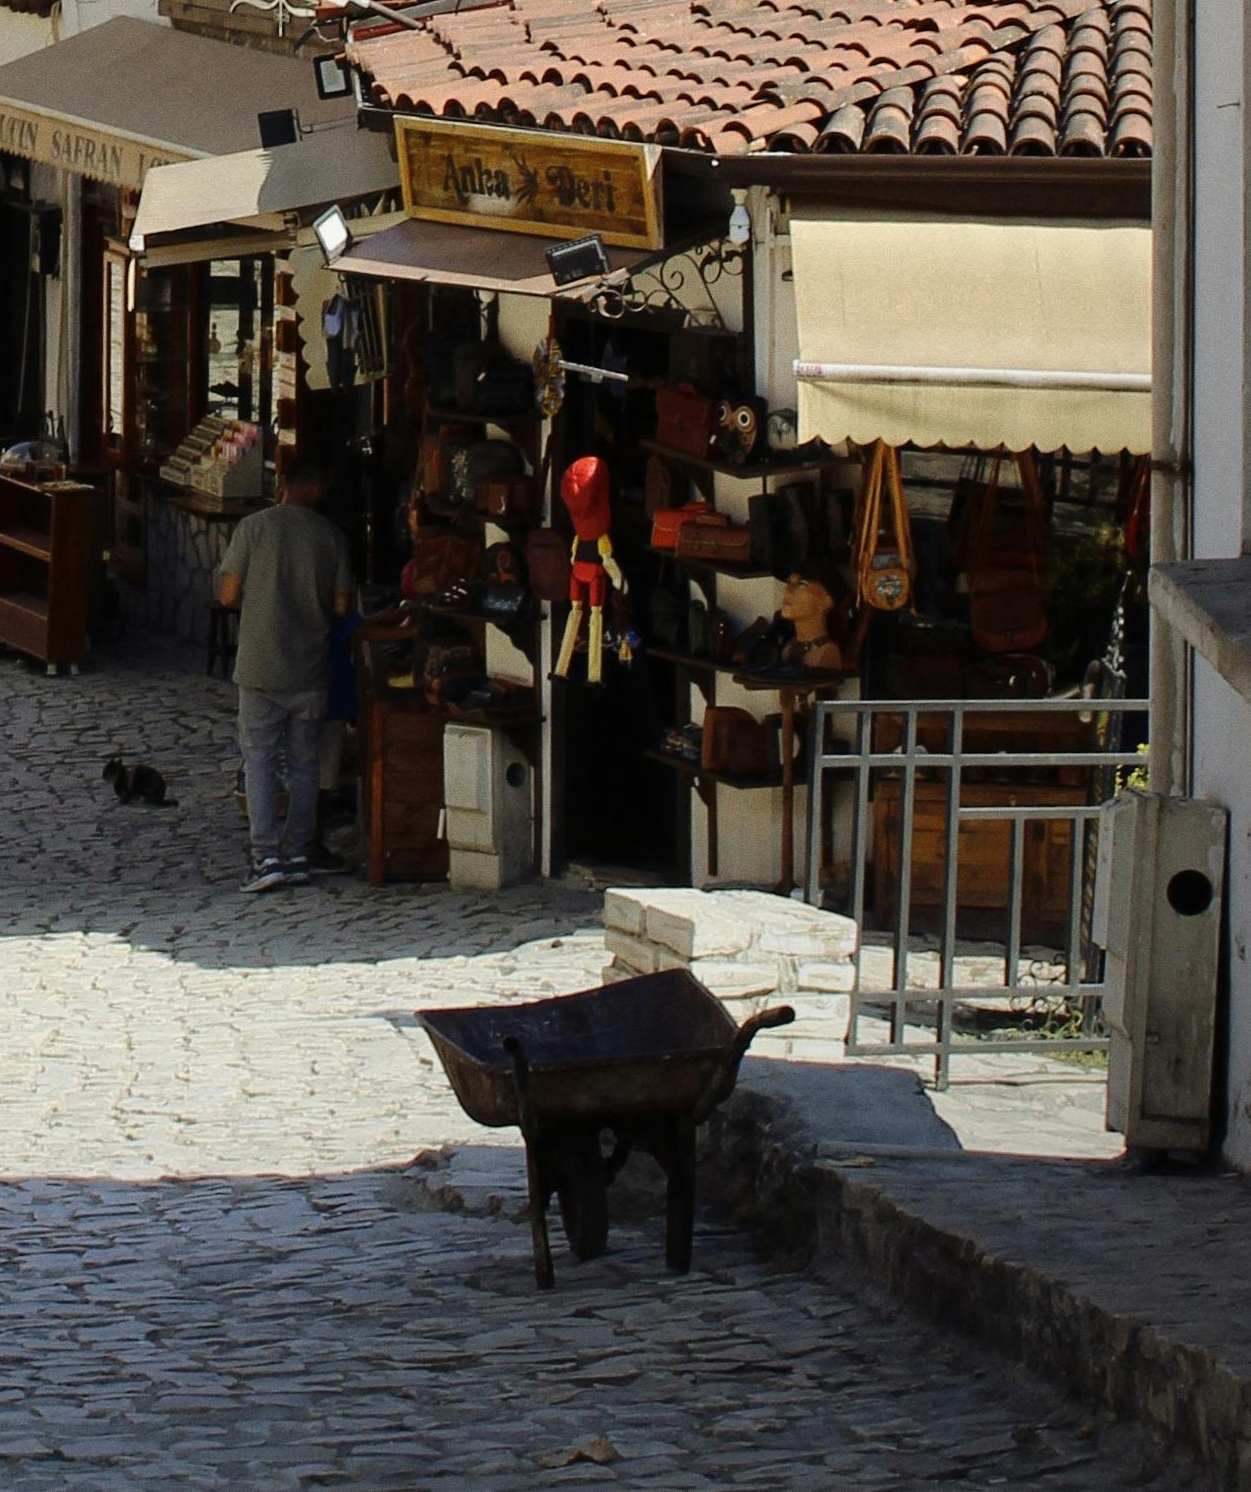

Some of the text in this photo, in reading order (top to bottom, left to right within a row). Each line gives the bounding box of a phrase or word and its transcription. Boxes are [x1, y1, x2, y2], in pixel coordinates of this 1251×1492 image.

[51, 129, 124, 178] SAFRAN
[442, 152, 616, 213] Anka Deri
